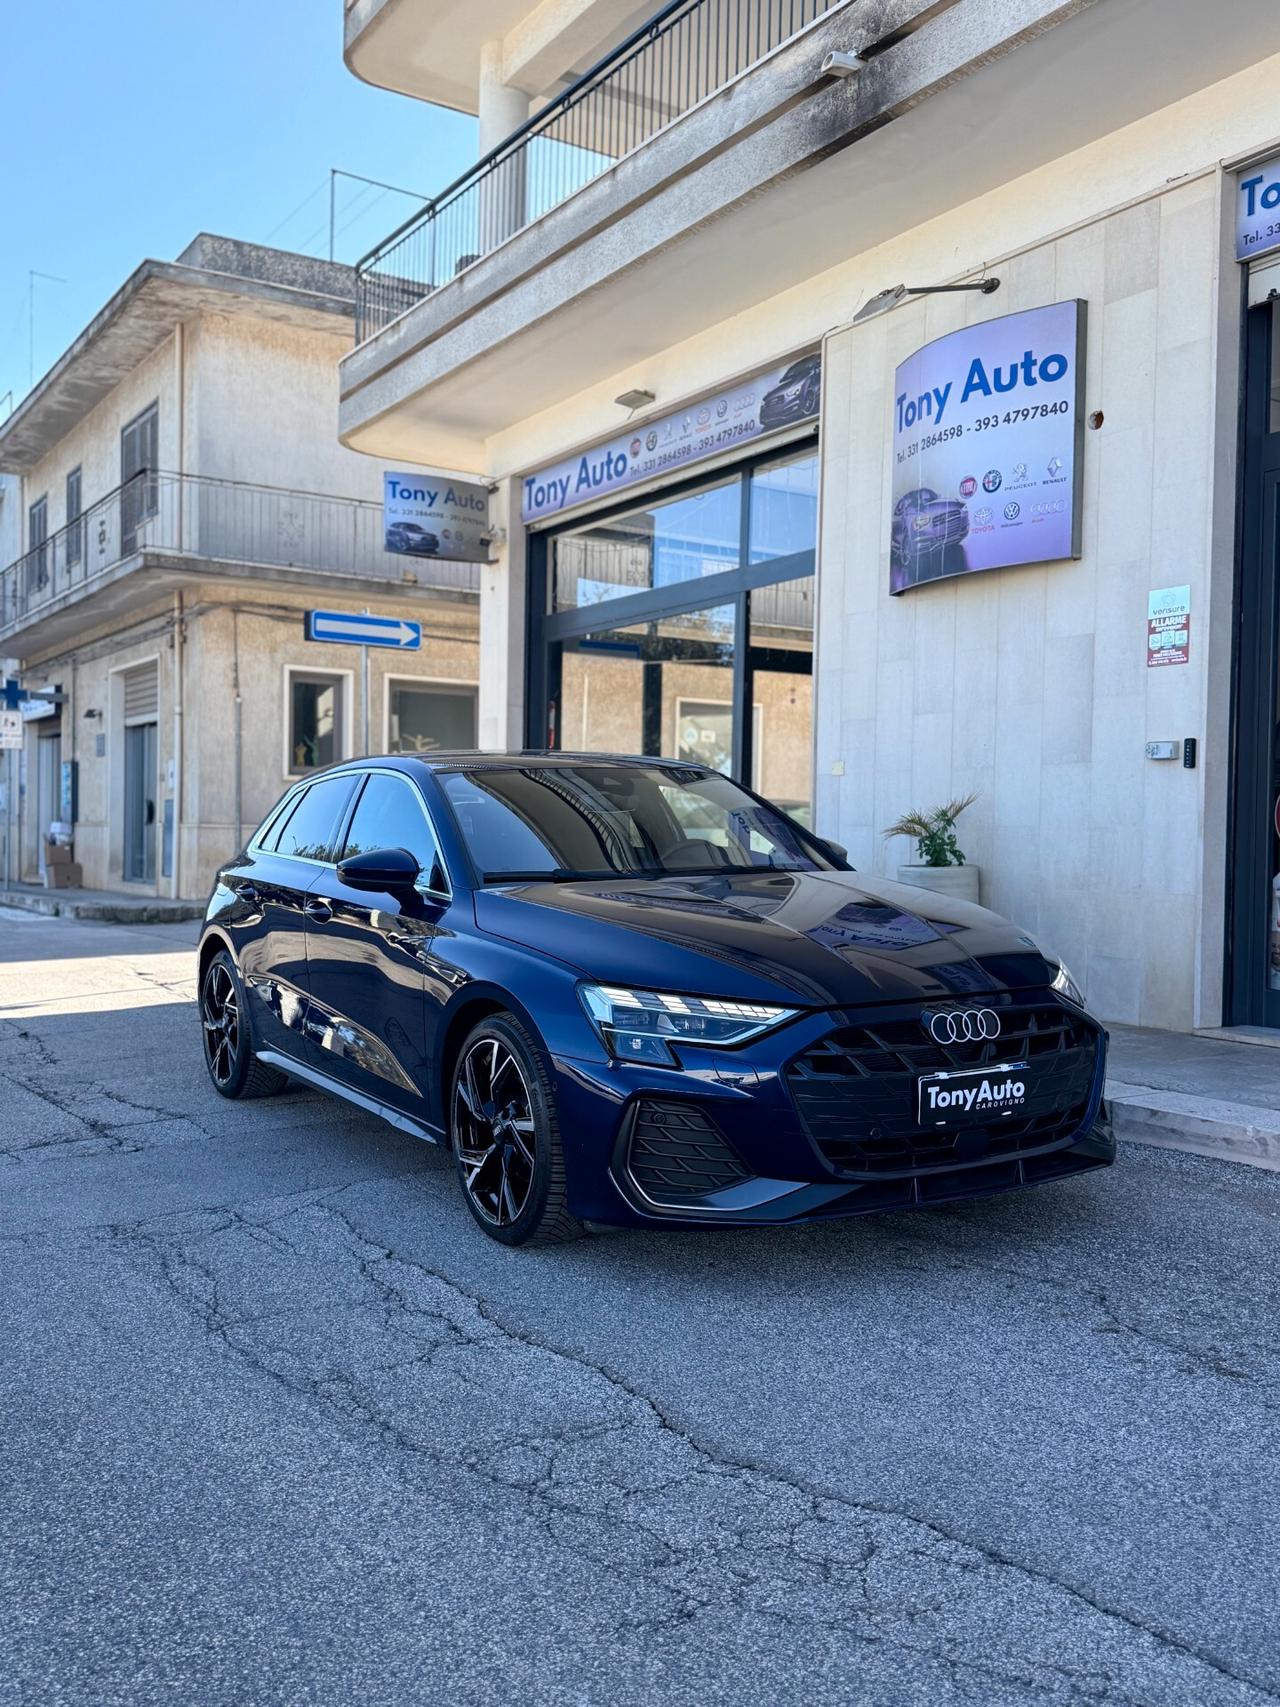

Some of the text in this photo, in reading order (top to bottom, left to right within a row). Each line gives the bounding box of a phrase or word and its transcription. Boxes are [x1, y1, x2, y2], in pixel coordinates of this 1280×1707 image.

[1243, 229, 1263, 246] Tel.
[896, 350, 1068, 433] Tony Auto
[643, 459, 656, 472] 331
[657, 443, 692, 466] 2864598
[699, 435, 714, 451] 393
[716, 418, 755, 442] 4797840
[897, 452, 907, 465] Tel.
[907, 442, 919, 459] 331
[921, 425, 963, 452] 2864598
[975, 415, 999, 433] 393
[1002, 400, 1069, 426] 4797840
[388, 480, 485, 512] Tony Auto
[525, 450, 628, 511] Tony Auto
[1151, 615, 1187, 628] ALLARME
[1153, 605, 1185, 615] verisure
[928, 1079, 1025, 1111] TonyAuto
[976, 1097, 1025, 1110] CAROVIGNO
